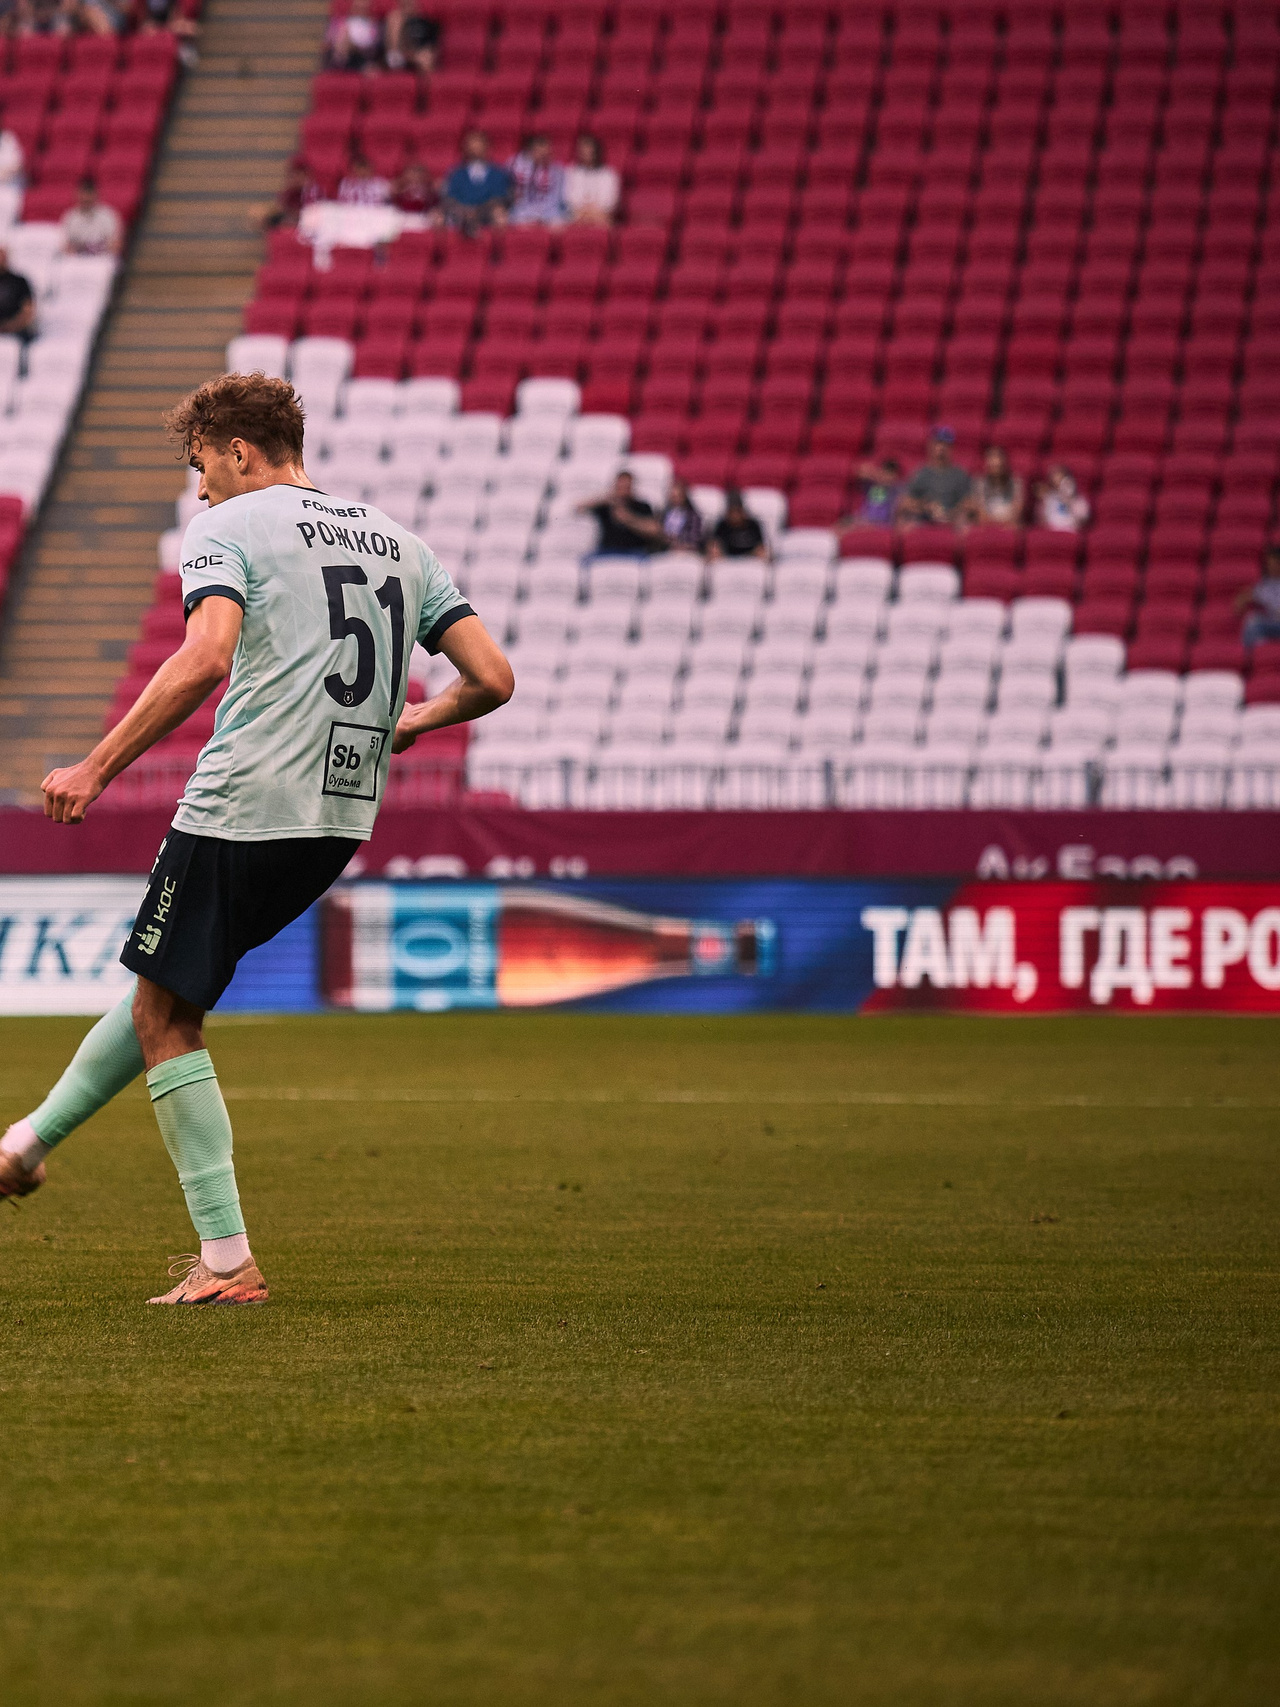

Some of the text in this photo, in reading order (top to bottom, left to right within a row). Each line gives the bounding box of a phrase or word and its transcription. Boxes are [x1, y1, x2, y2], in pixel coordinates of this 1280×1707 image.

[301, 499, 367, 518] FONBET
[296, 520, 401, 562] РОЖКОВ
[321, 565, 404, 717] 51
[369, 736, 380, 750] 51
[332, 744, 361, 771] Sb
[328, 773, 361, 788] Сурьма
[860, 904, 1038, 1003] ТАМ,
[1058, 904, 1194, 1005] ГДЕ
